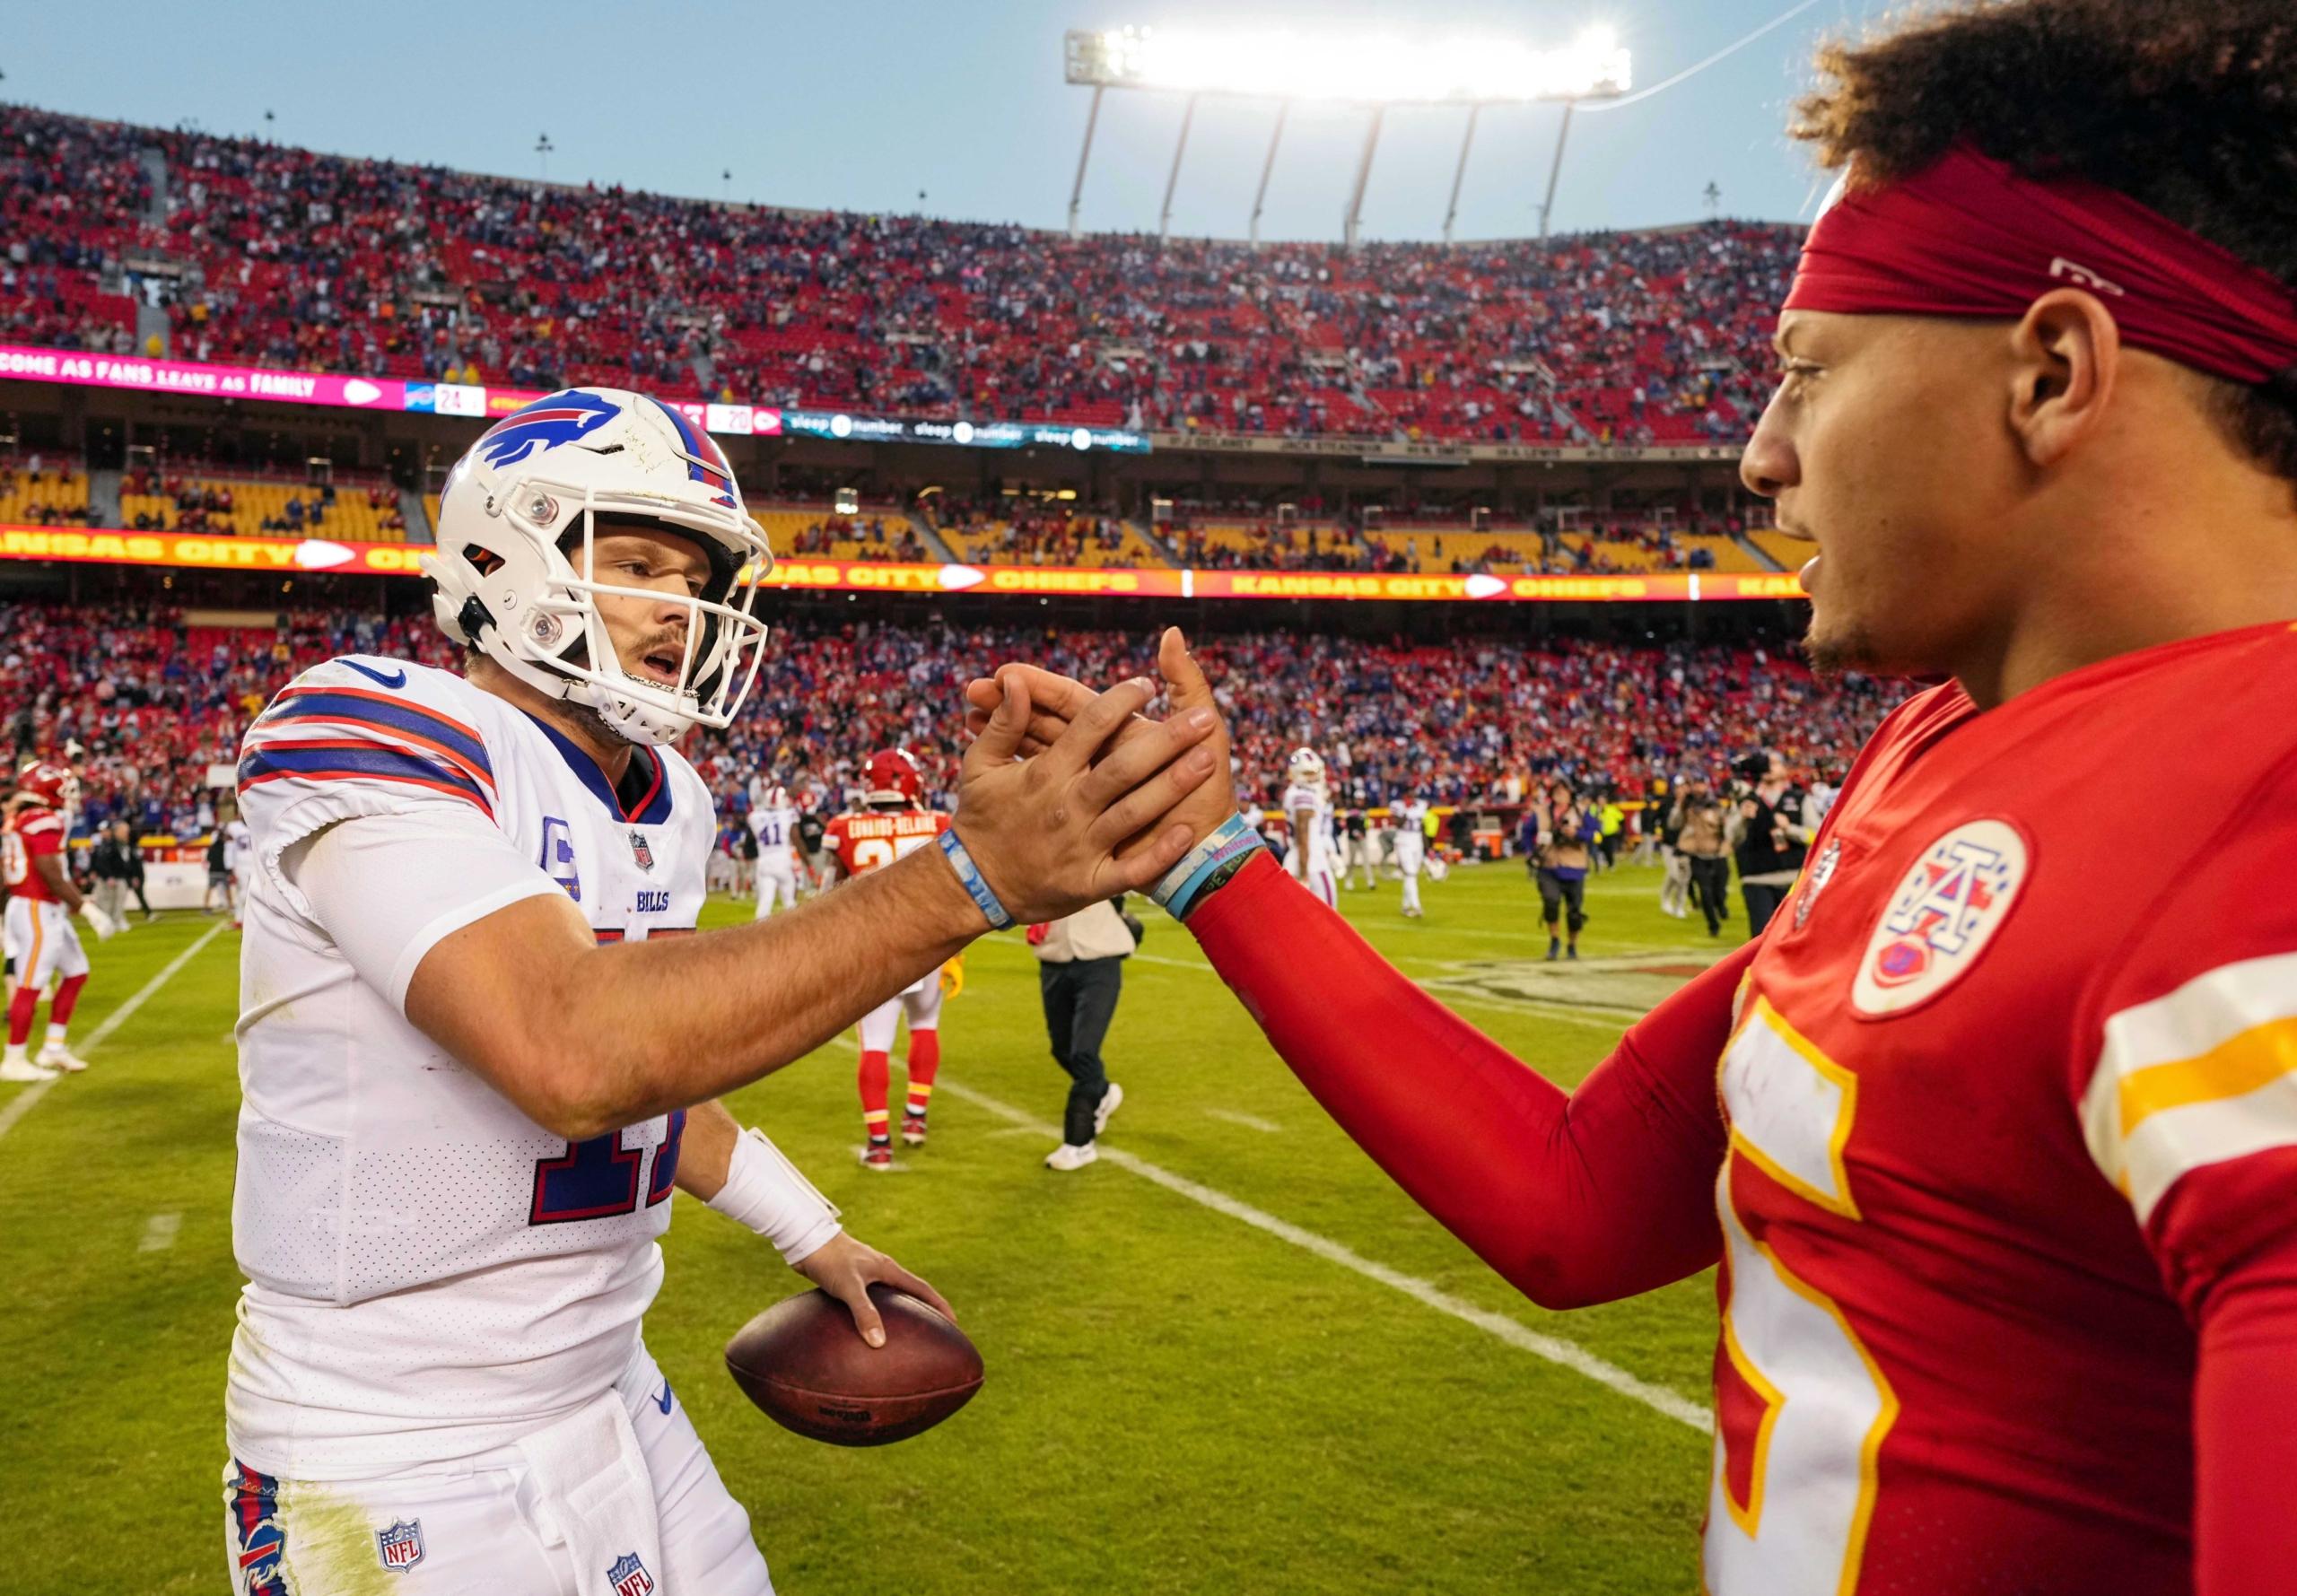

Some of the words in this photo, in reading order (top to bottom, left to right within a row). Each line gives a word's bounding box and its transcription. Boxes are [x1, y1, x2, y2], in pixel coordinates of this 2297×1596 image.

[0, 353, 57, 376] COME
[60, 359, 93, 379] AS
[96, 361, 153, 384] FANS
[156, 369, 216, 390] LEAVE
[221, 375, 246, 393] AS
[250, 373, 316, 397] FAMILY
[441, 390, 461, 410] 24
[790, 414, 829, 432] sleep
[852, 418, 904, 434] number
[0, 530, 165, 560] NSAS
[174, 539, 298, 566] CITY
[846, 566, 940, 588] CITY
[993, 570, 1139, 592] CHIEFS
[1231, 575, 1382, 596] KANSAS
[1386, 576, 1466, 596] CITY
[1512, 578, 1646, 598] CHIEFS
[759, 822, 782, 846] 41
[636, 891, 669, 912] BILLS
[1886, 840, 2002, 955] A
[385, 1539, 420, 1565] NFL
[616, 1571, 652, 1596] NFL
